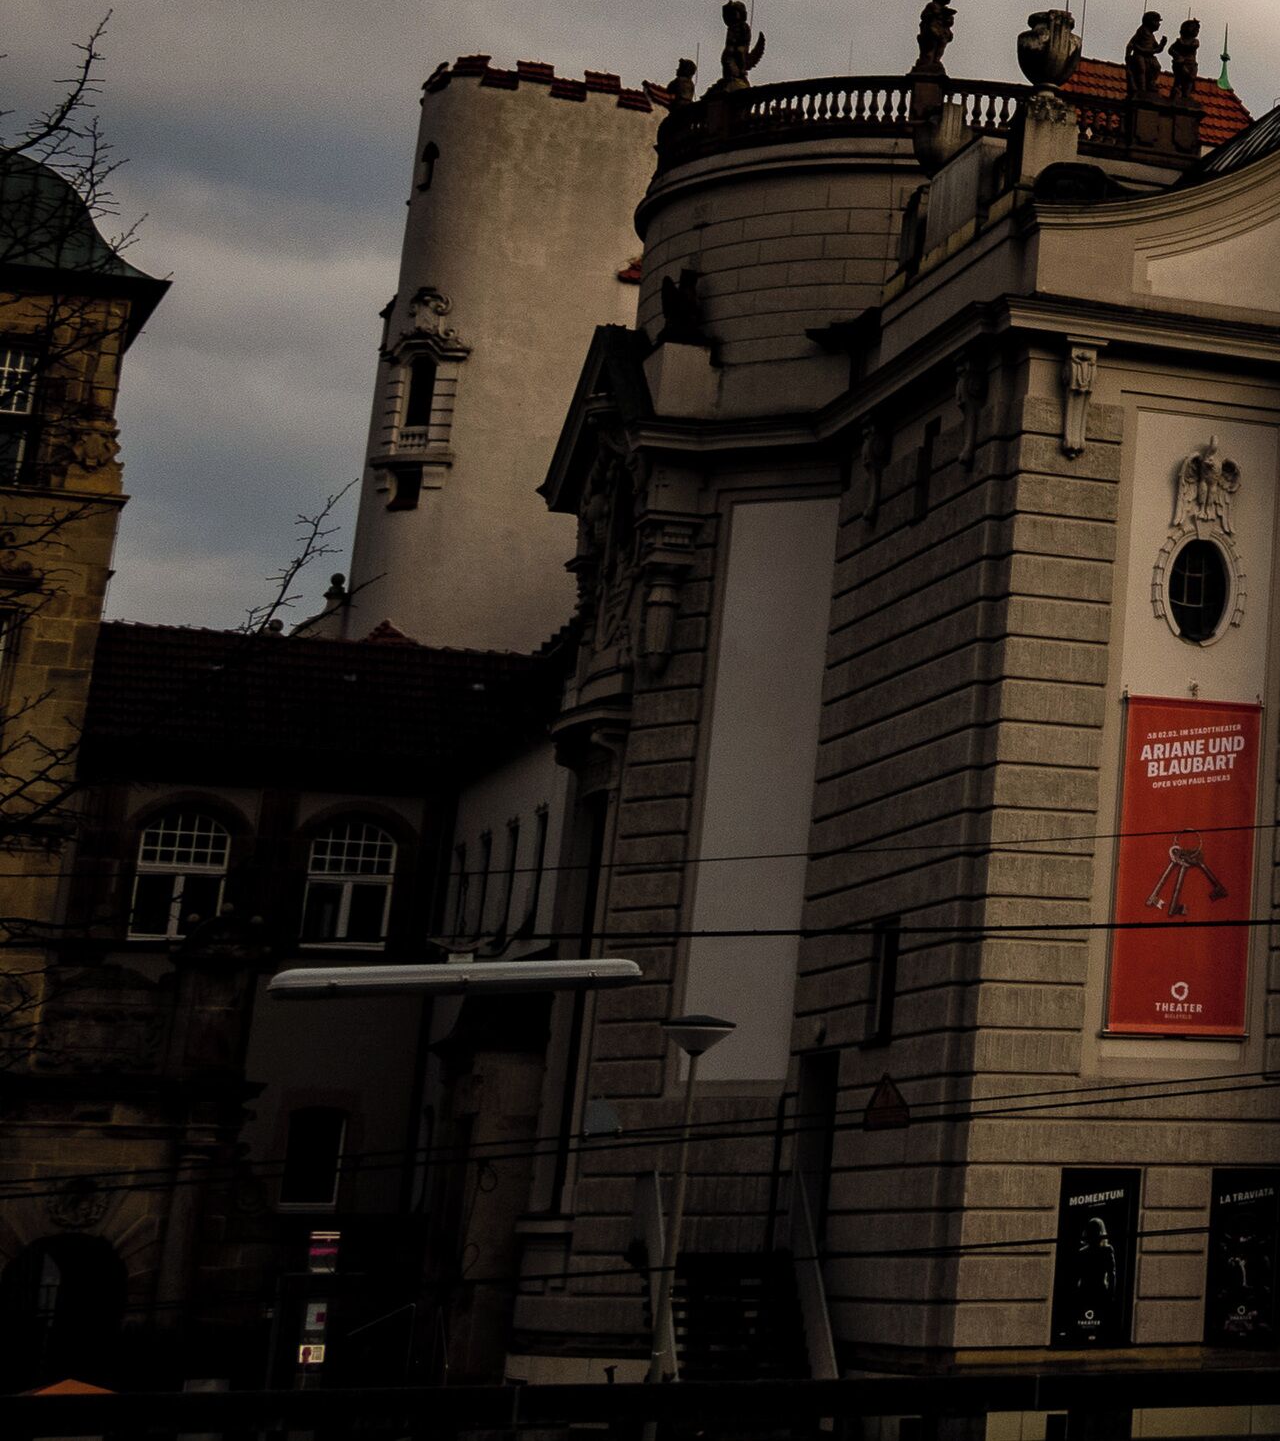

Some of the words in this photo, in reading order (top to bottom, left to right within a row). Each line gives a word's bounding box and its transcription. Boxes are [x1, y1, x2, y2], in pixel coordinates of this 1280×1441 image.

[1190, 724, 1241, 735] STADTTHEATER
[1140, 739, 1205, 761] ARIANE
[1208, 735, 1245, 754] UND
[1147, 753, 1237, 777] BLAUBART
[1152, 780, 1171, 789] OPER
[1172, 779, 1187, 787] VON
[1188, 777, 1206, 785] PAUL
[1207, 774, 1231, 783] DUKAS
[1155, 1002, 1203, 1013] THEATER
[1069, 1188, 1125, 1206] MOMENTUM
[1220, 1194, 1231, 1205] LA
[1232, 1187, 1274, 1202] TRAVIATA
